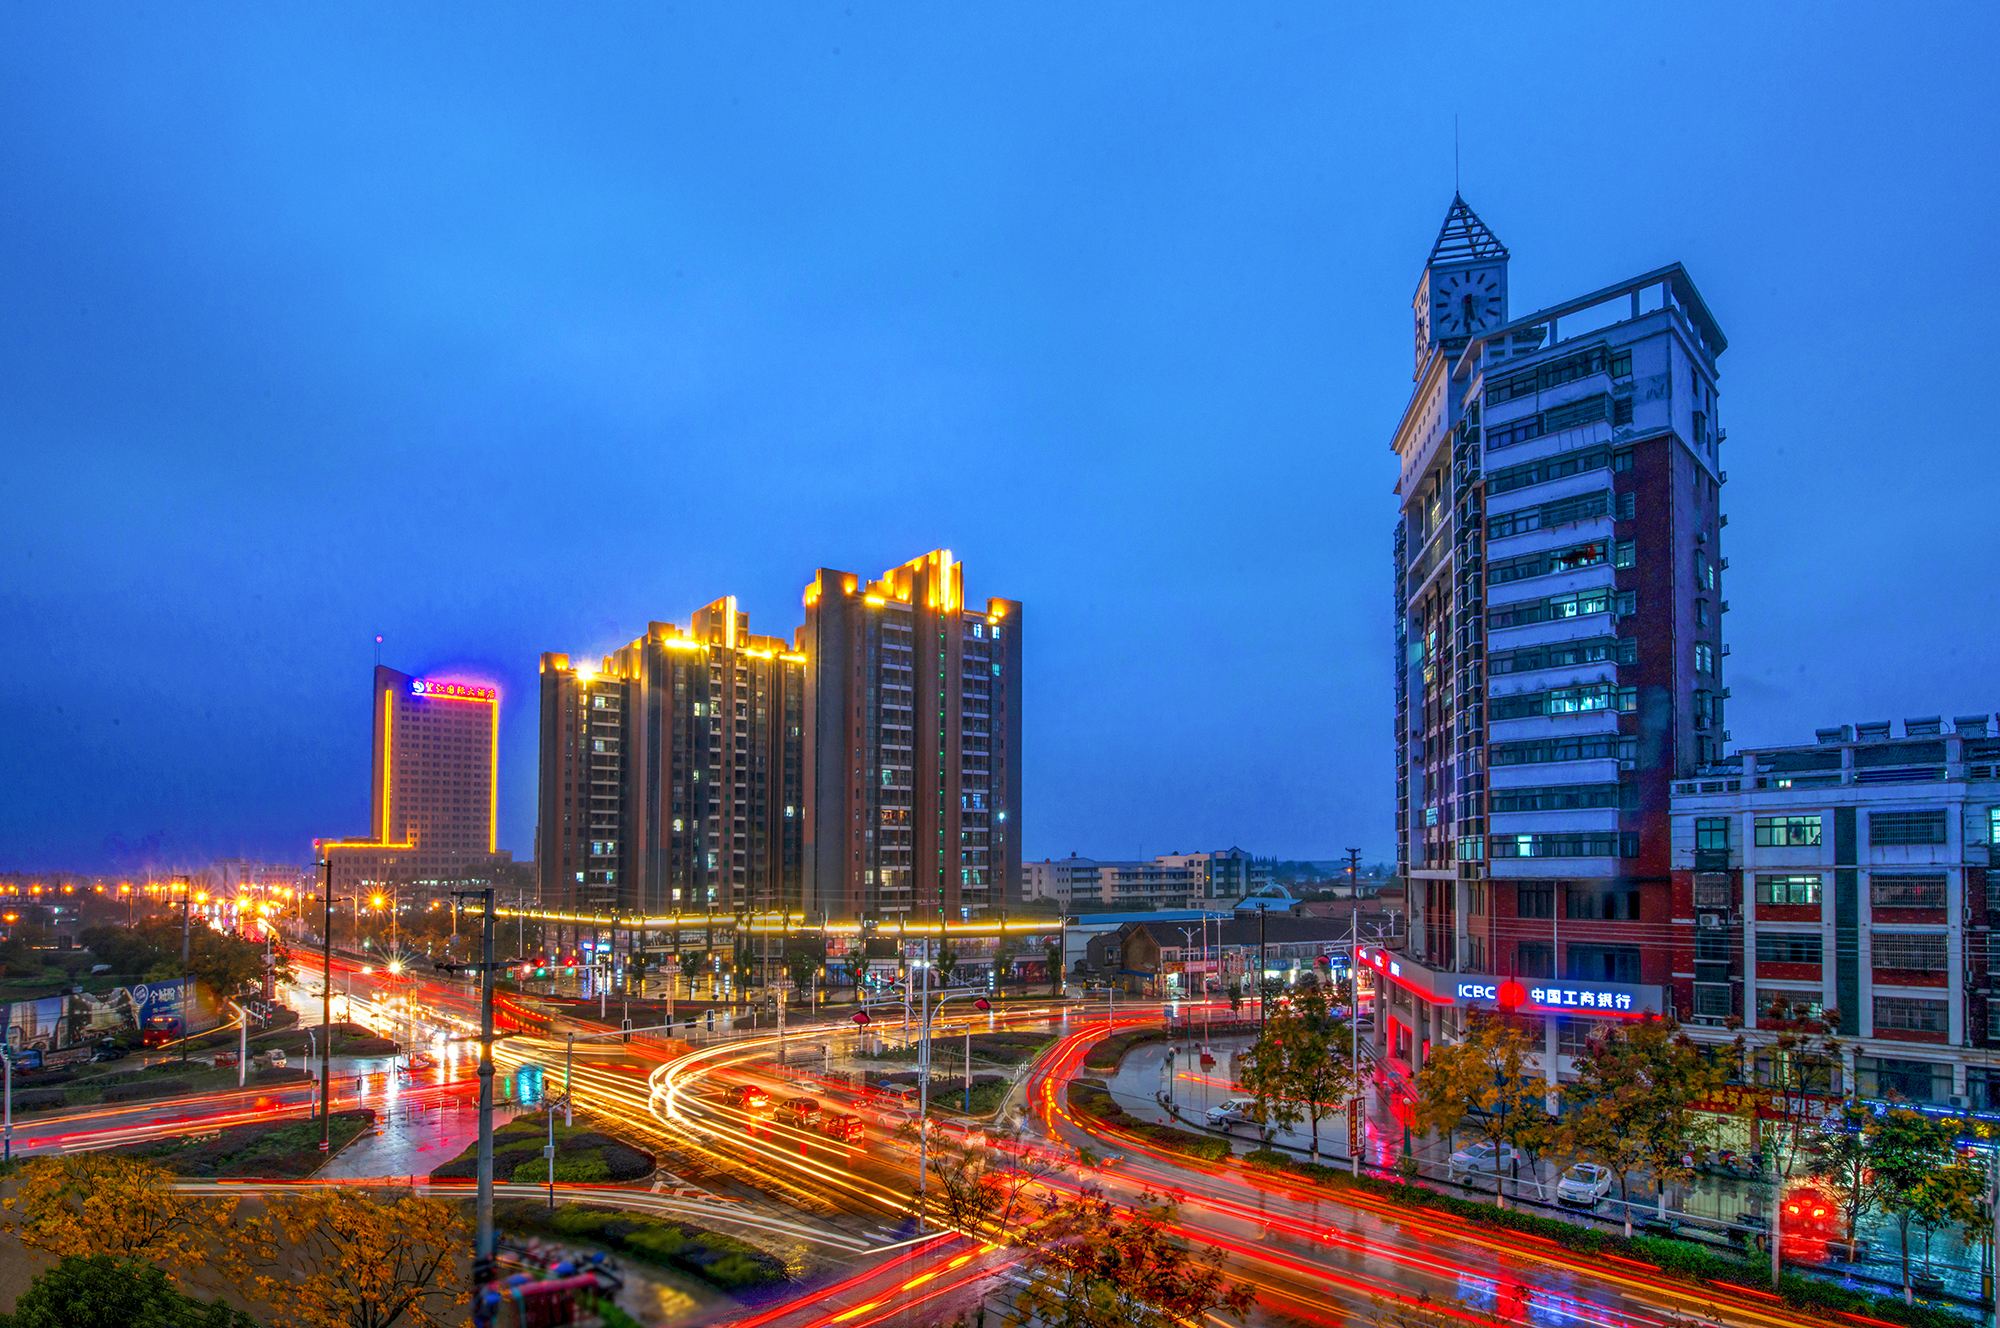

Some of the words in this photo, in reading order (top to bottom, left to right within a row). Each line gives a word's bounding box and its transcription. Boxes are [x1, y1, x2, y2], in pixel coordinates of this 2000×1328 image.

[1458, 984, 1496, 1000] ICBC
[1531, 987, 1631, 1010] 中国工商银行
